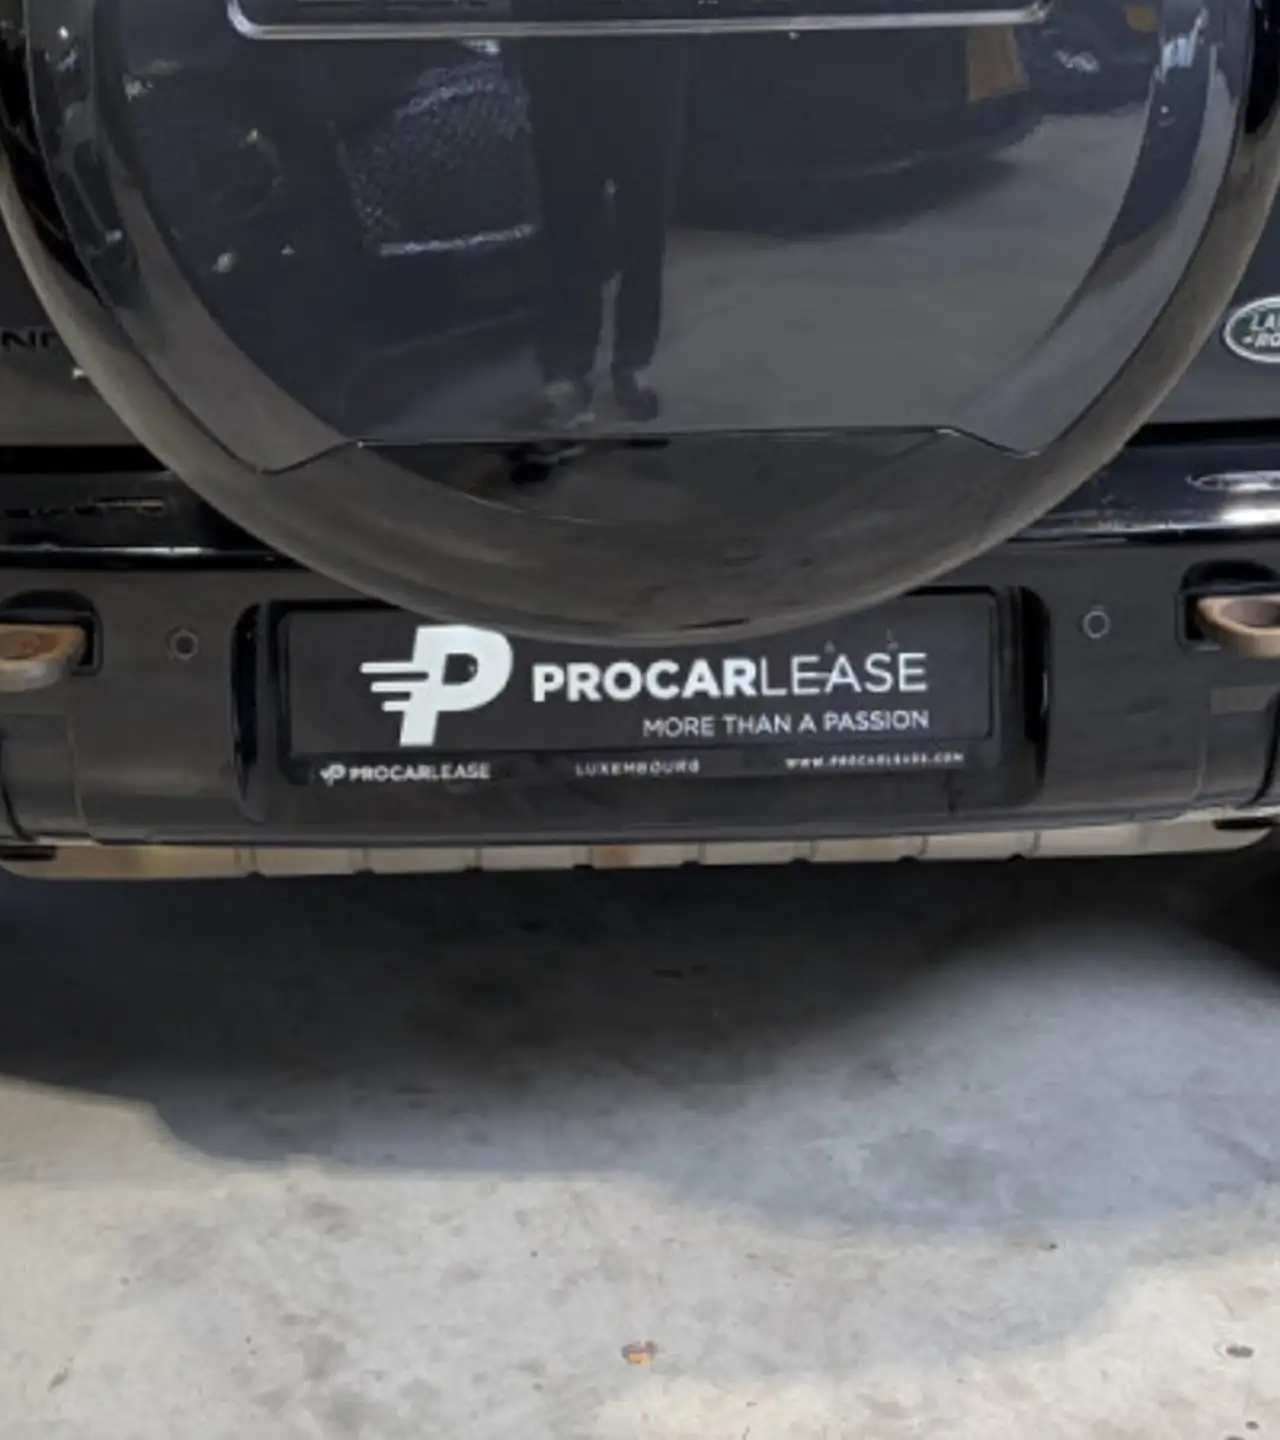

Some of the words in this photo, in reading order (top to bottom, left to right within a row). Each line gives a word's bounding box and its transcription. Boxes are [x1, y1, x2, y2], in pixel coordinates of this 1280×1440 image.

[532, 651, 929, 703] PROCARLEASE
[642, 716, 716, 739] MORE
[723, 714, 793, 736] THAN
[798, 713, 819, 734] A
[823, 710, 930, 733] PASSION
[349, 762, 492, 783] PROCARLEASE
[575, 759, 701, 777] LUXEMBOURG
